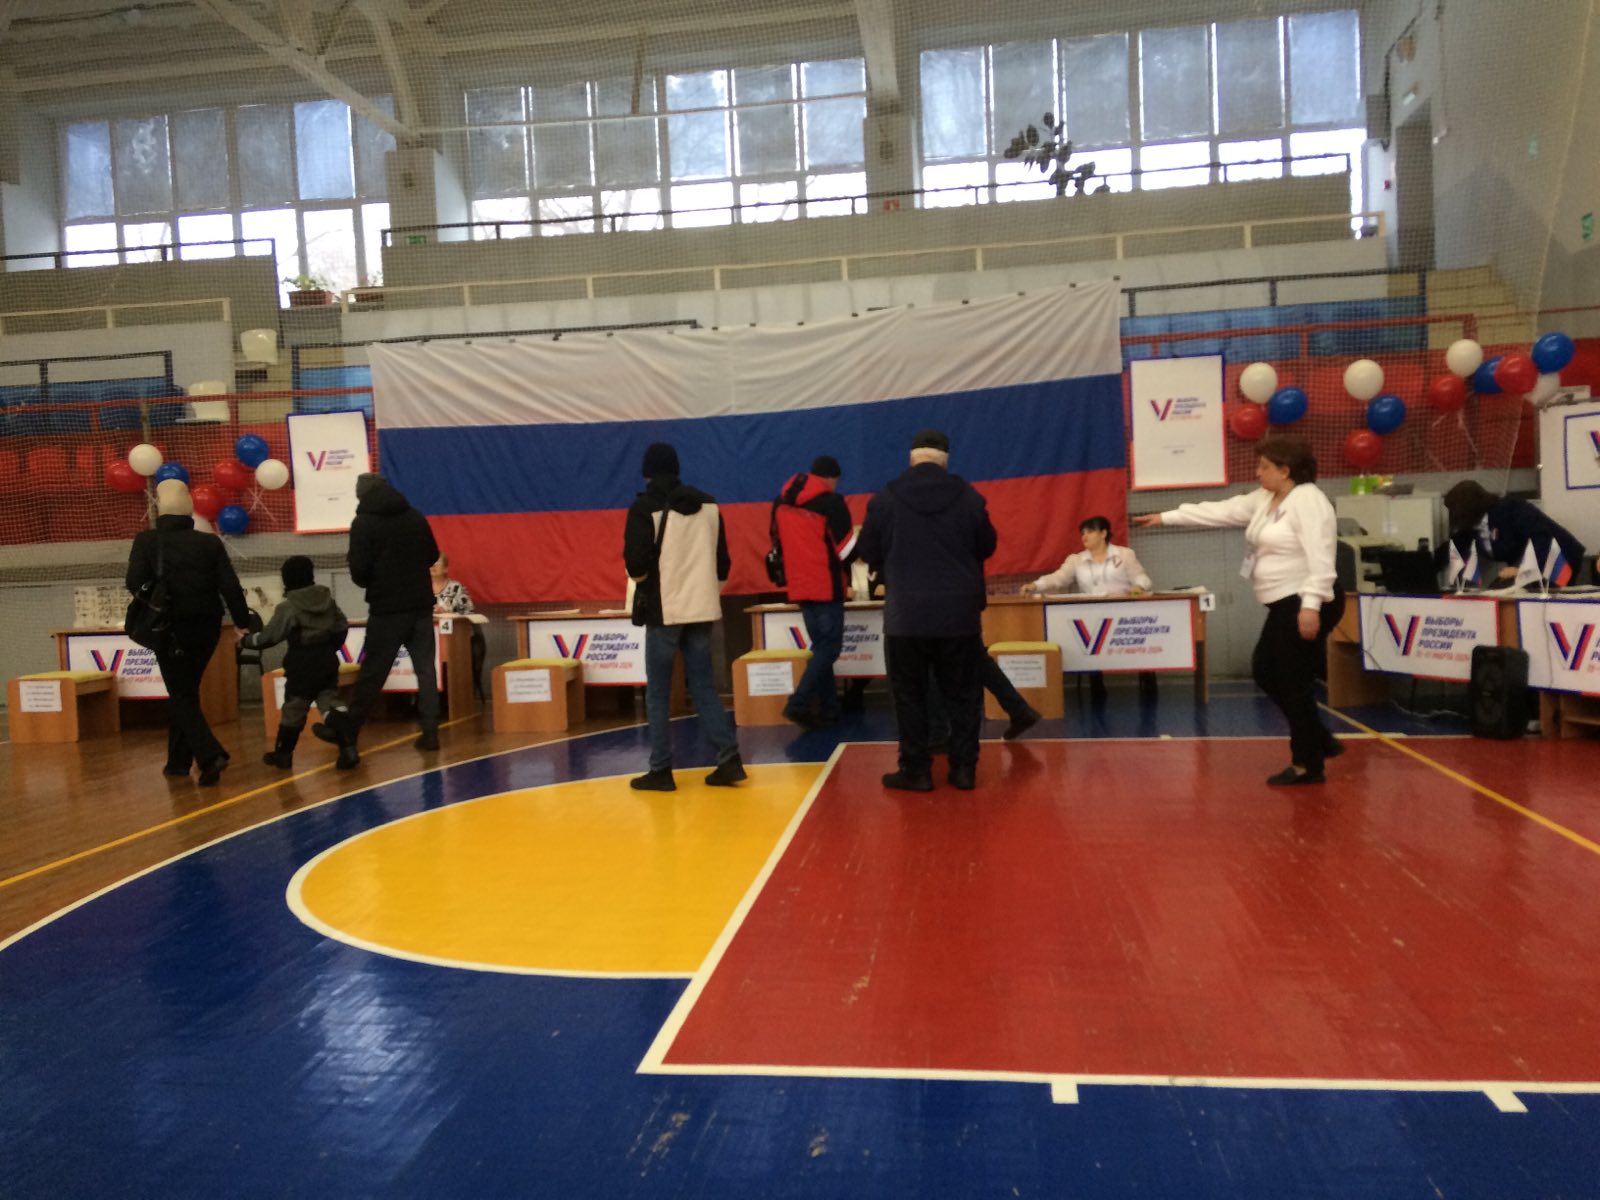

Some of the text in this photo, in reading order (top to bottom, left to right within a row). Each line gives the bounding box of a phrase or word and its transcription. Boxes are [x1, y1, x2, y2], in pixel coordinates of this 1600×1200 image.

[1118, 616, 1158, 625] ВЫБОРЫ
[1424, 616, 1464, 627] ВЫБОРЫ
[441, 621, 450, 631] 4
[1113, 625, 1170, 635] ПРЕЗИДЕНТА
[592, 633, 629, 642] ВЫБОРЫ
[1421, 628, 1477, 639] ПРЕЗИДЕНТА
[1109, 637, 1146, 646] РОССИИ
[1418, 640, 1453, 650] РОССИИ
[588, 642, 639, 651] ПРЕЗИДЕНТА
[585, 653, 618, 661] РОССИИ
[122, 668, 152, 676] РОССИИ
